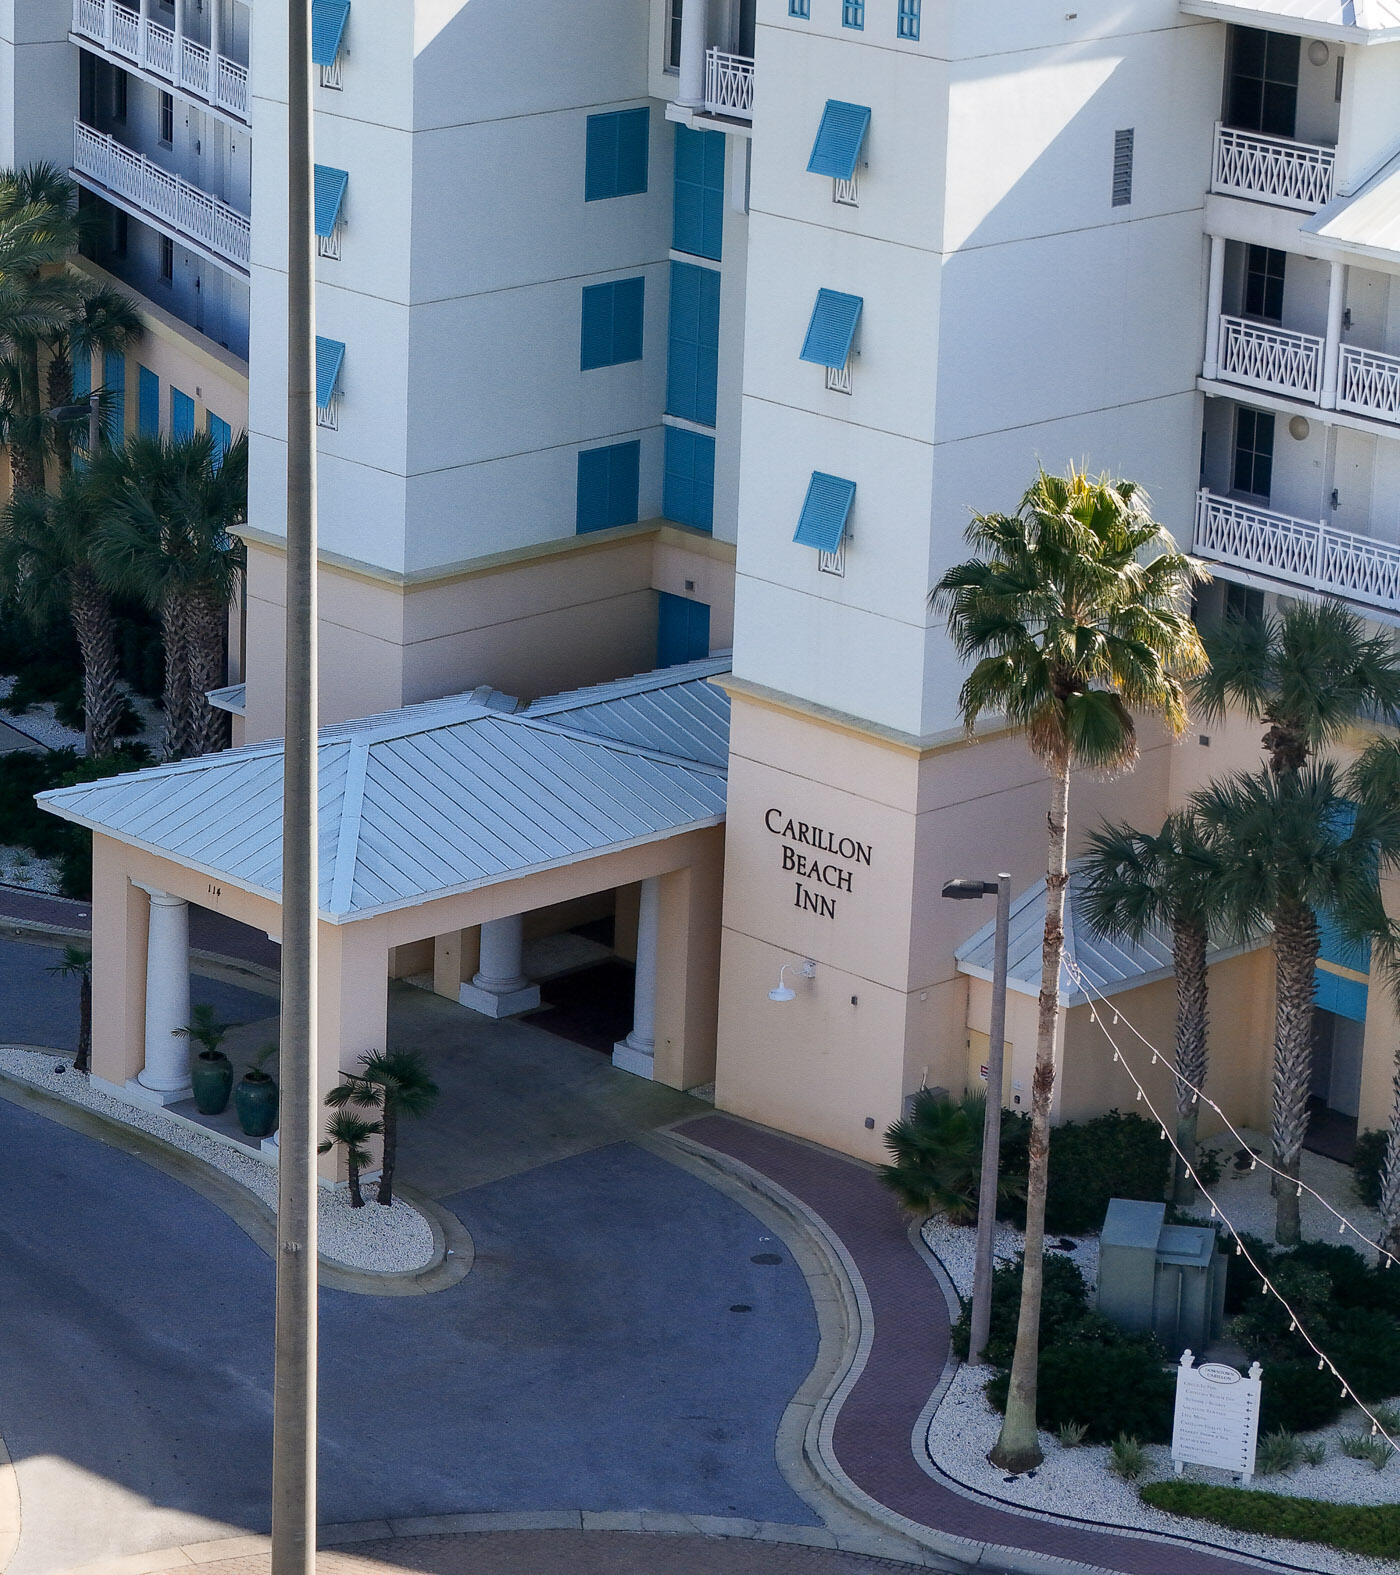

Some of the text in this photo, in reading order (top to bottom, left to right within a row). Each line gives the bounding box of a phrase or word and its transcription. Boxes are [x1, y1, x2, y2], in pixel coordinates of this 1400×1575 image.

[765, 808, 872, 866] CARILLON
[208, 884, 221, 896] 114
[782, 844, 853, 893] BEACH
[794, 882, 836, 920] INN
